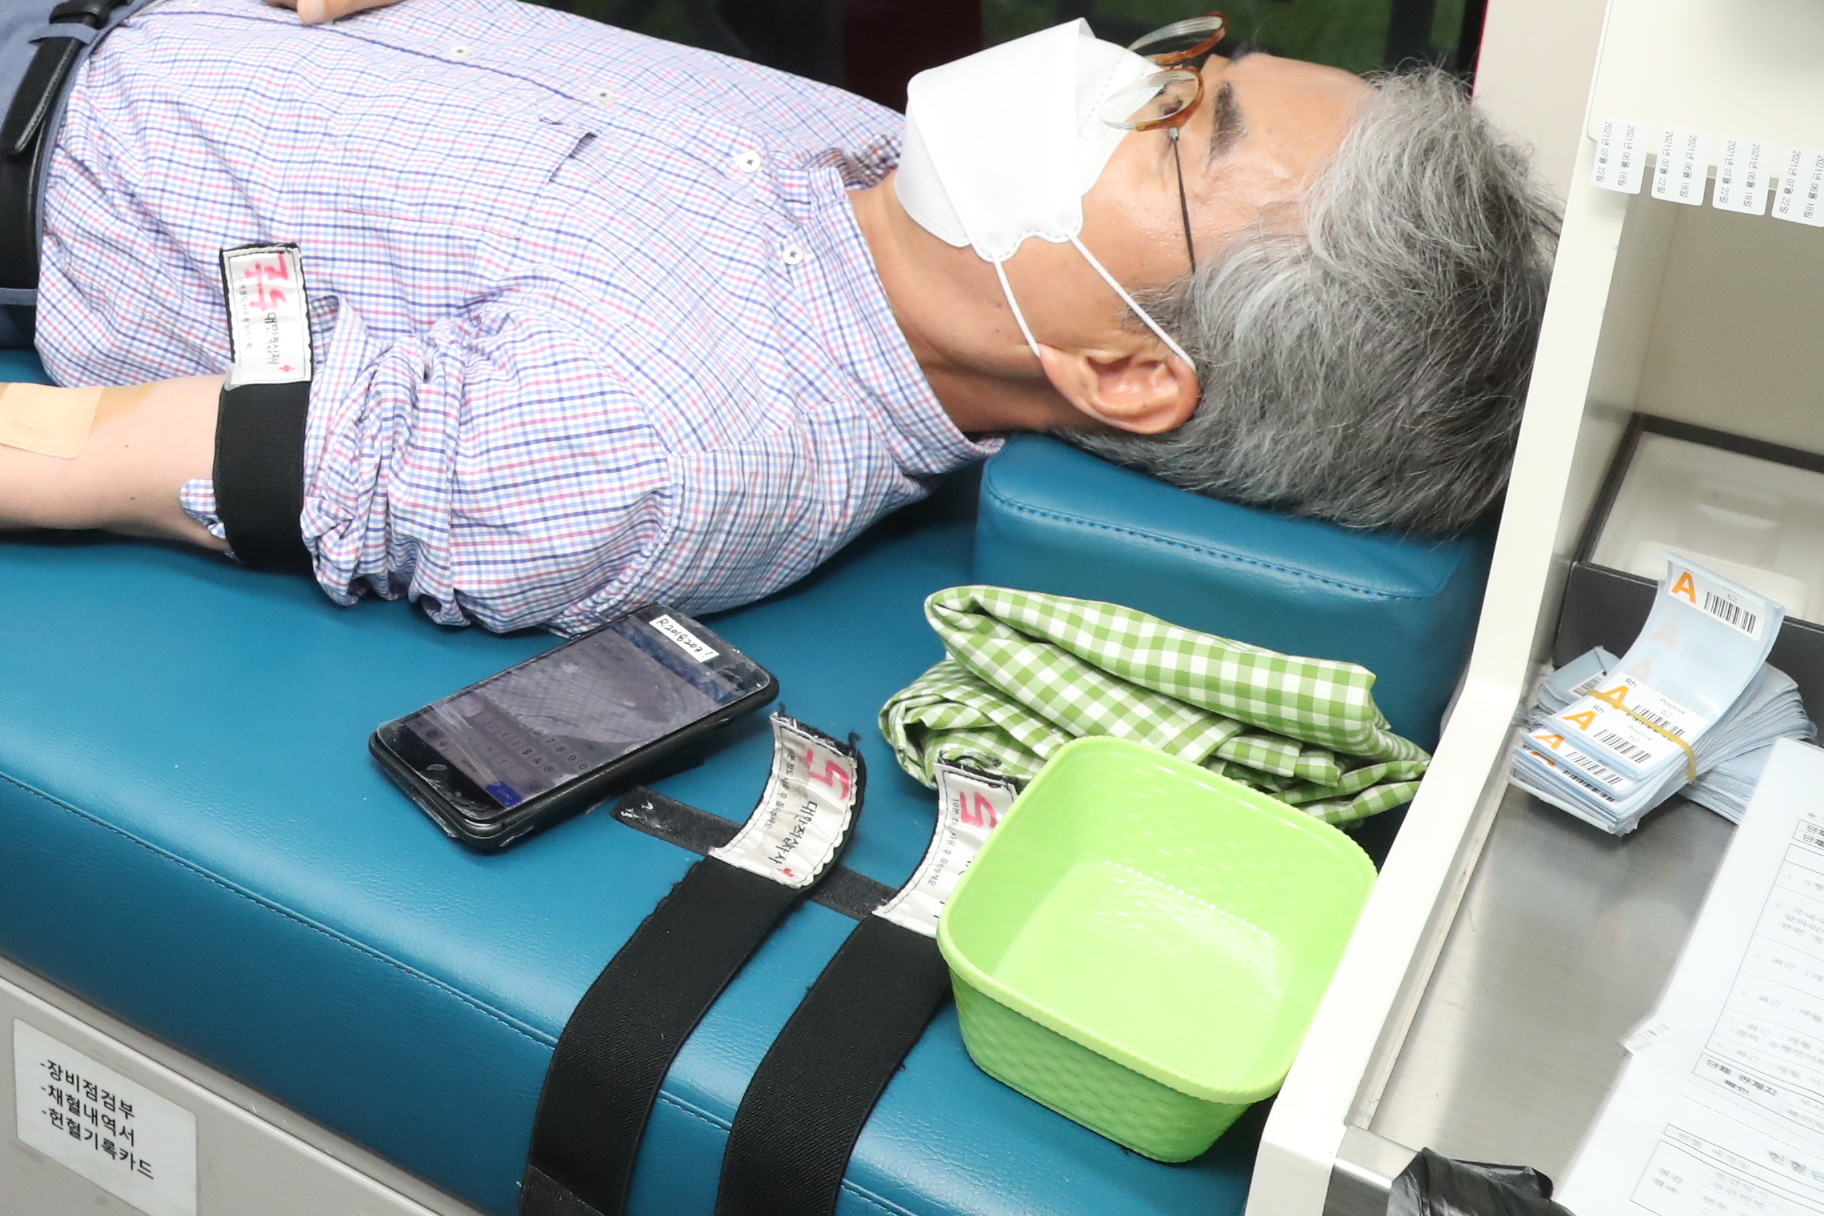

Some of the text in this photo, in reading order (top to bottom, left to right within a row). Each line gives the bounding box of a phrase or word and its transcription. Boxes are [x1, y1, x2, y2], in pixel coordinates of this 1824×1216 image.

[1671, 571, 1697, 604] A
[1727, 592, 1738, 603] 62
[1625, 677, 1637, 688] Rh
[1593, 704, 1605, 715] Rh
[1659, 697, 1687, 716] Positive
[1562, 710, 1597, 731] A
[1627, 724, 1653, 742] Positive
[768, 800, 819, 865] 대한적십자사
[40, 1058, 135, 1120] -장비점검부
[40, 1084, 135, 1147] -채혈내역서
[41, 1107, 155, 1181] -헌혈기록카드
